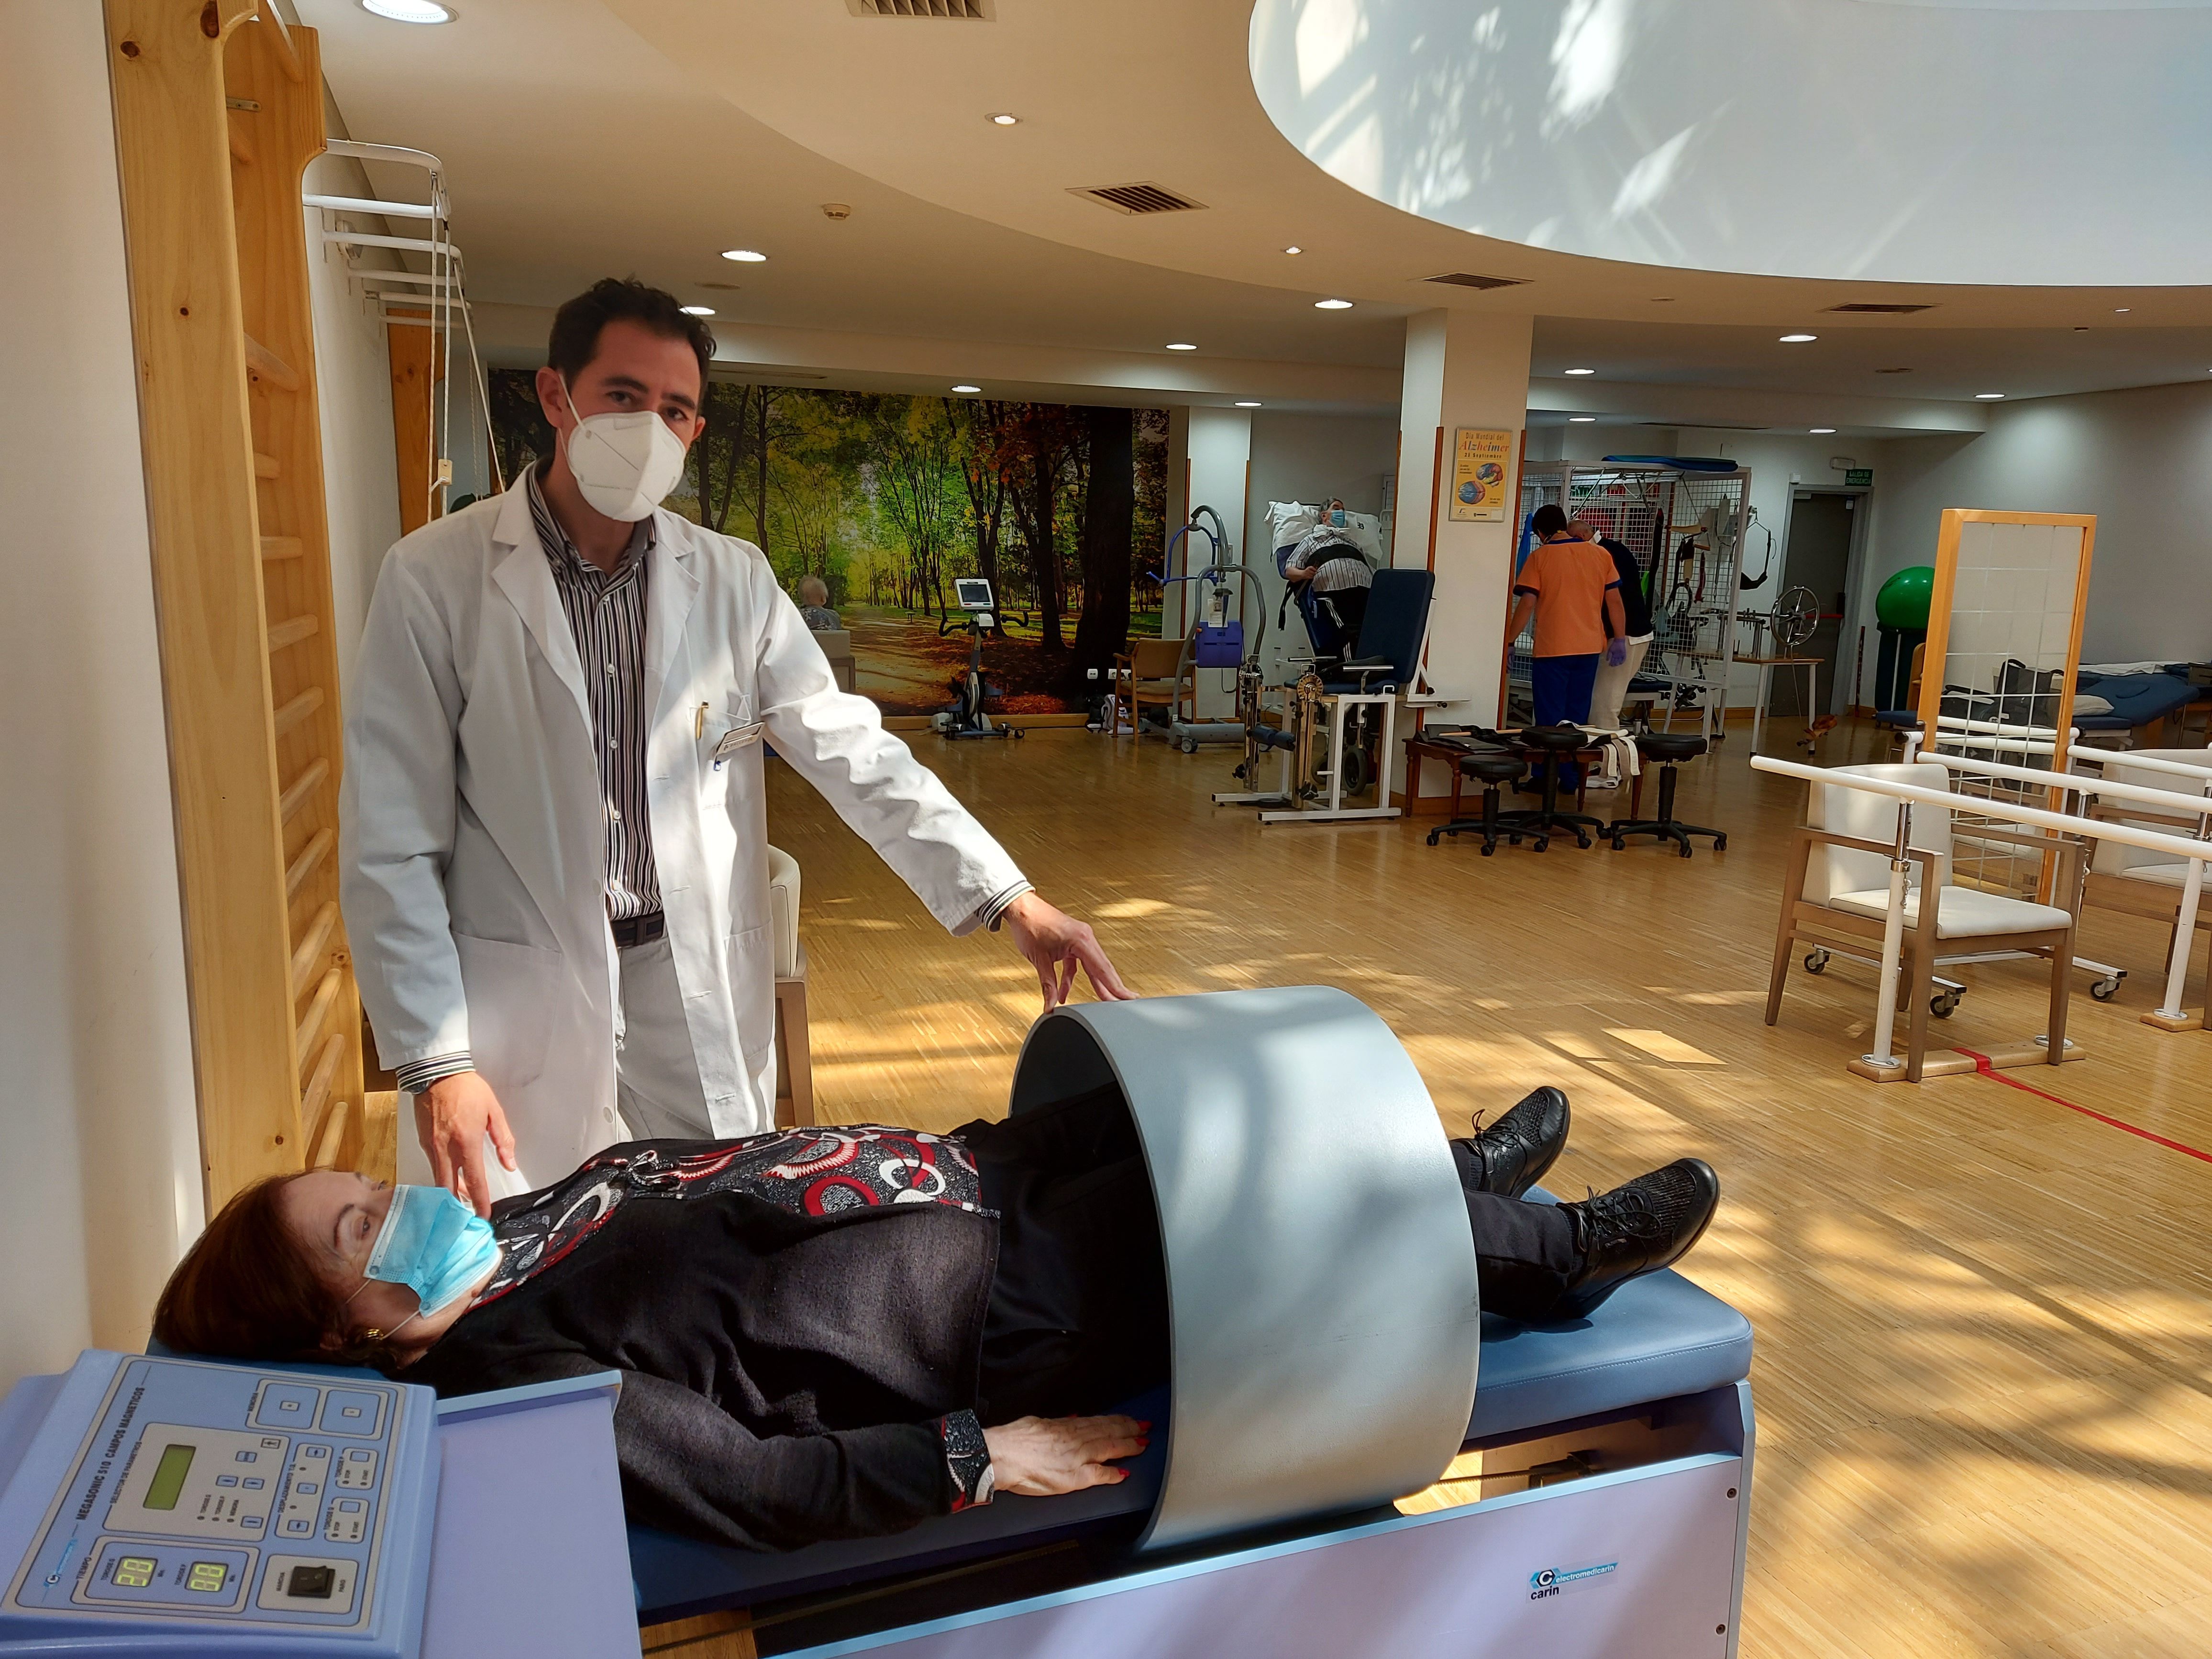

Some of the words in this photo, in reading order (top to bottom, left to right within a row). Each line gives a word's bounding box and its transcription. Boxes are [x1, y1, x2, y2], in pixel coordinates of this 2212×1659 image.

[1459, 441, 1509, 452] Alzheimer
[76, 1475, 105, 1520] MEGASONIC
[97, 1461, 111, 1474] 510
[105, 1429, 126, 1458] CAMPOS
[118, 1387, 145, 1428] MAGNETICOS
[110, 1480, 126, 1504] SELECTOR
[124, 1442, 142, 1471] PARAMETROS
[277, 1472, 293, 1513] DESPLAZAMIENTO
[76, 1557, 92, 1579] TIEMPO
[117, 1559, 153, 1587] 20
[190, 1564, 224, 1592] 00
[1555, 1565, 1615, 1583] electromedicarin
[276, 1572, 285, 1592] MARCHA
[1531, 1586, 1559, 1600] carin
